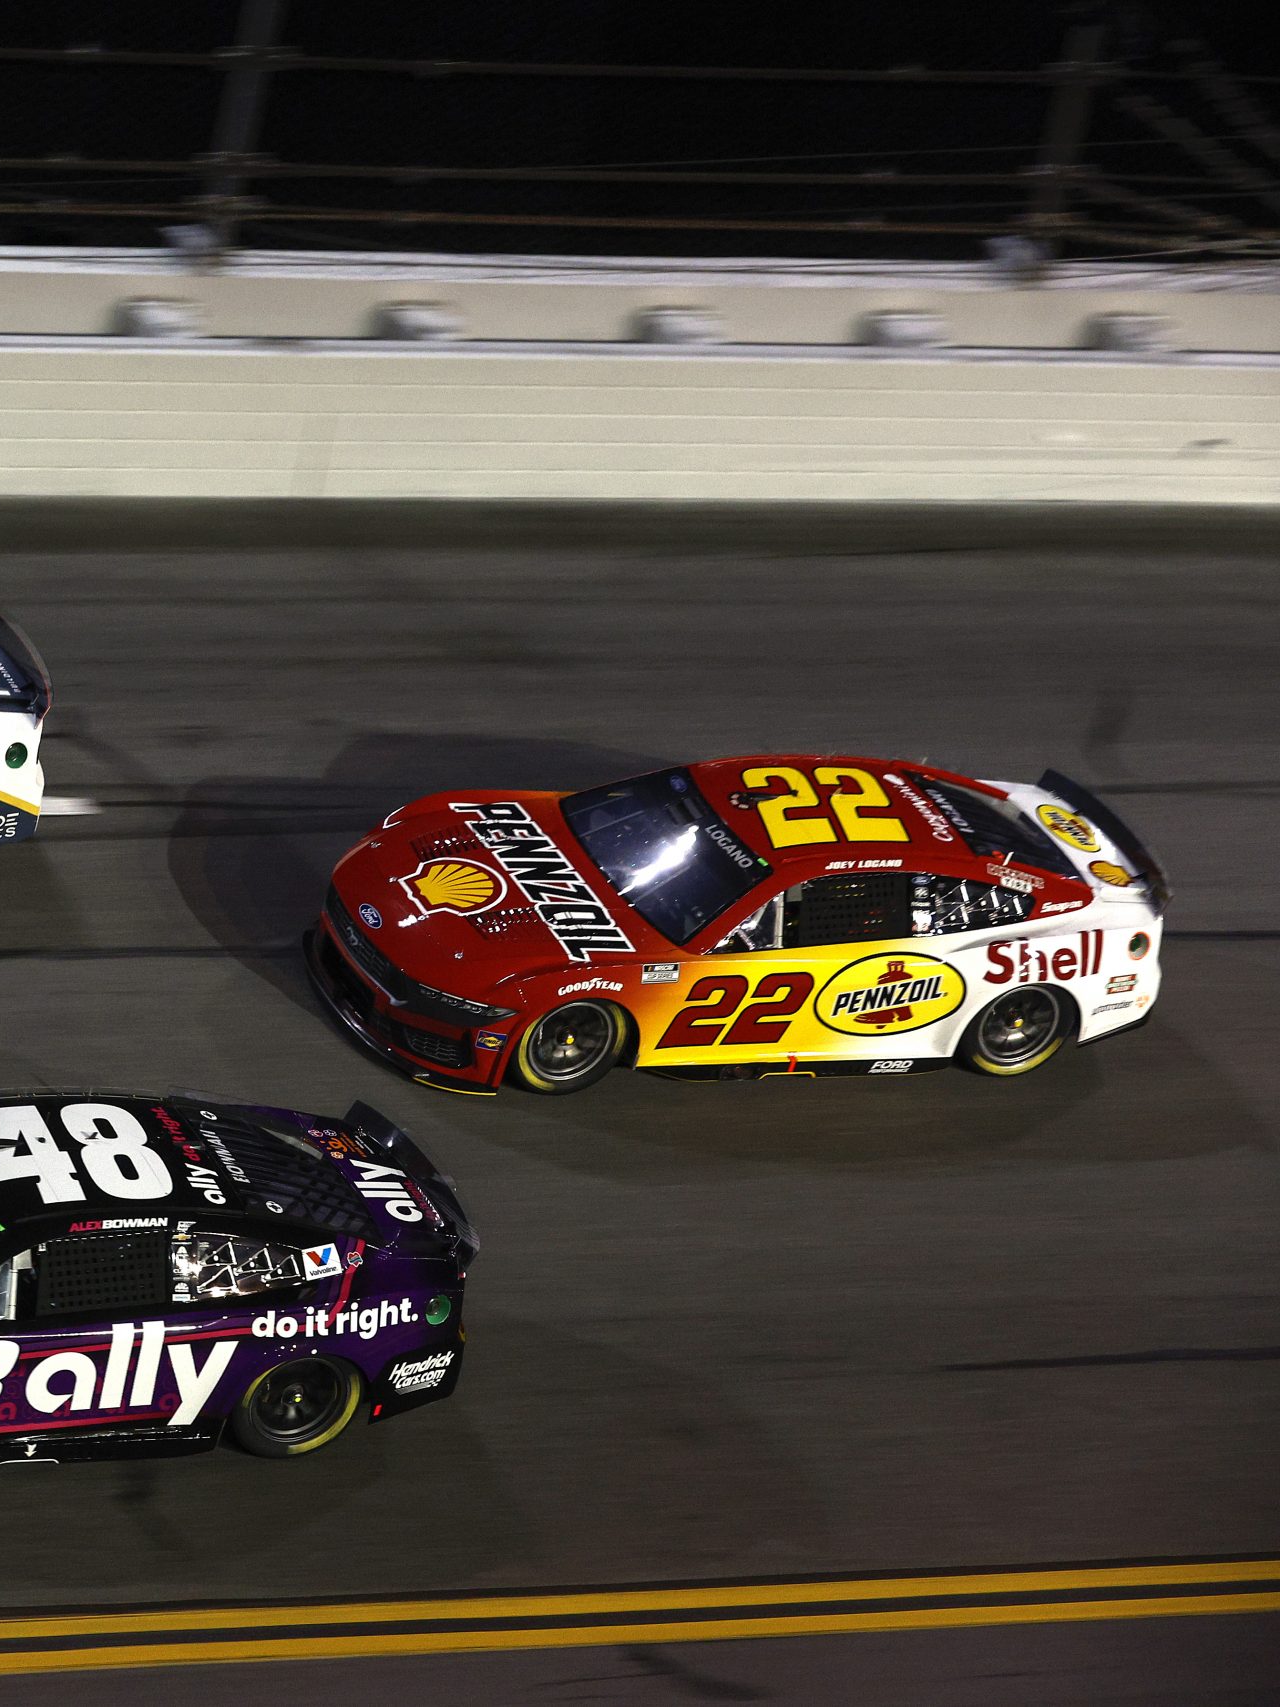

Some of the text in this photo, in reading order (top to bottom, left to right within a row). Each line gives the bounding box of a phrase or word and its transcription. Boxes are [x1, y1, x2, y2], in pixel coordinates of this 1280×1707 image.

[741, 766, 911, 849] 22
[705, 824, 754, 869] LOGANO
[825, 859, 903, 870] JOEY LOGANO
[448, 802, 637, 963] PENNZOIL
[983, 929, 1104, 984] Shell
[557, 977, 624, 996] GOODYEAR
[831, 974, 944, 1018] PENNZOIL
[654, 971, 816, 1050] 22
[871, 1060, 914, 1069] FORD
[184, 1163, 227, 1204] ally
[349, 1159, 423, 1222] ally
[252, 1297, 419, 1340] do it right.
[25, 1320, 239, 1426] ally
[388, 1350, 455, 1381] Hendrick
